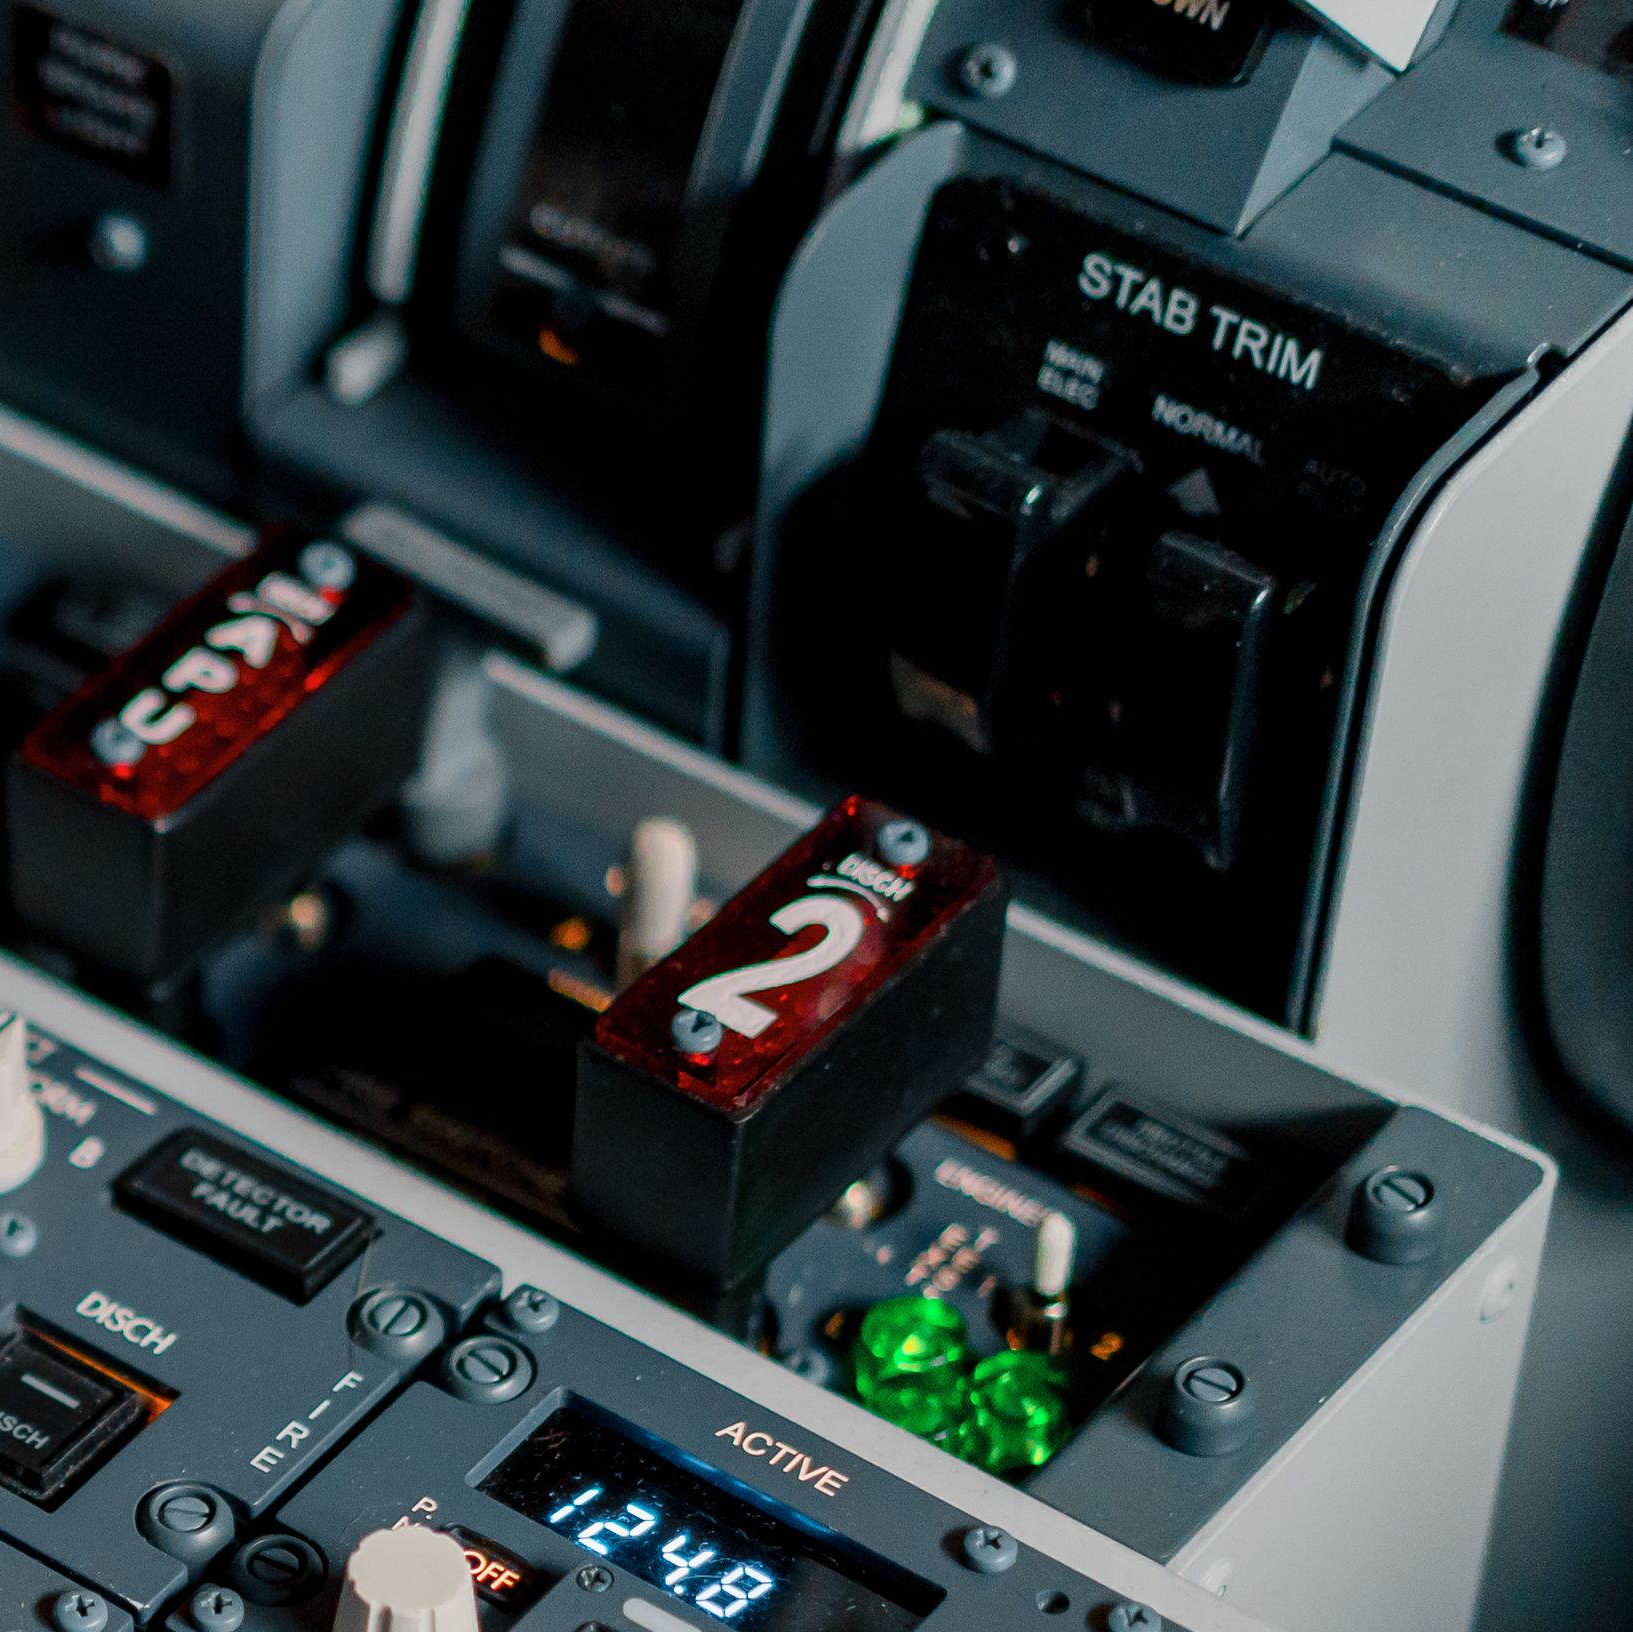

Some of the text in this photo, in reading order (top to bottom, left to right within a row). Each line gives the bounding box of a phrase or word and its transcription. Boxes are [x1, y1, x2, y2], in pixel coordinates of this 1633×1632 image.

[1078, 251, 1324, 391] STAB TRIM
[1044, 338, 1106, 383] MAIN
[1151, 393, 1266, 467] NORMAL
[119, 612, 279, 745] APU
[836, 852, 914, 902] DISCH
[678, 893, 867, 1040] 2
[68, 1136, 106, 1171] B
[180, 1148, 334, 1236] DETECTOR
[191, 1183, 284, 1234] FAULT
[75, 1290, 179, 1357] DISCH
[249, 1369, 365, 1474] FIRE
[714, 1419, 849, 1498] ACTIVE
